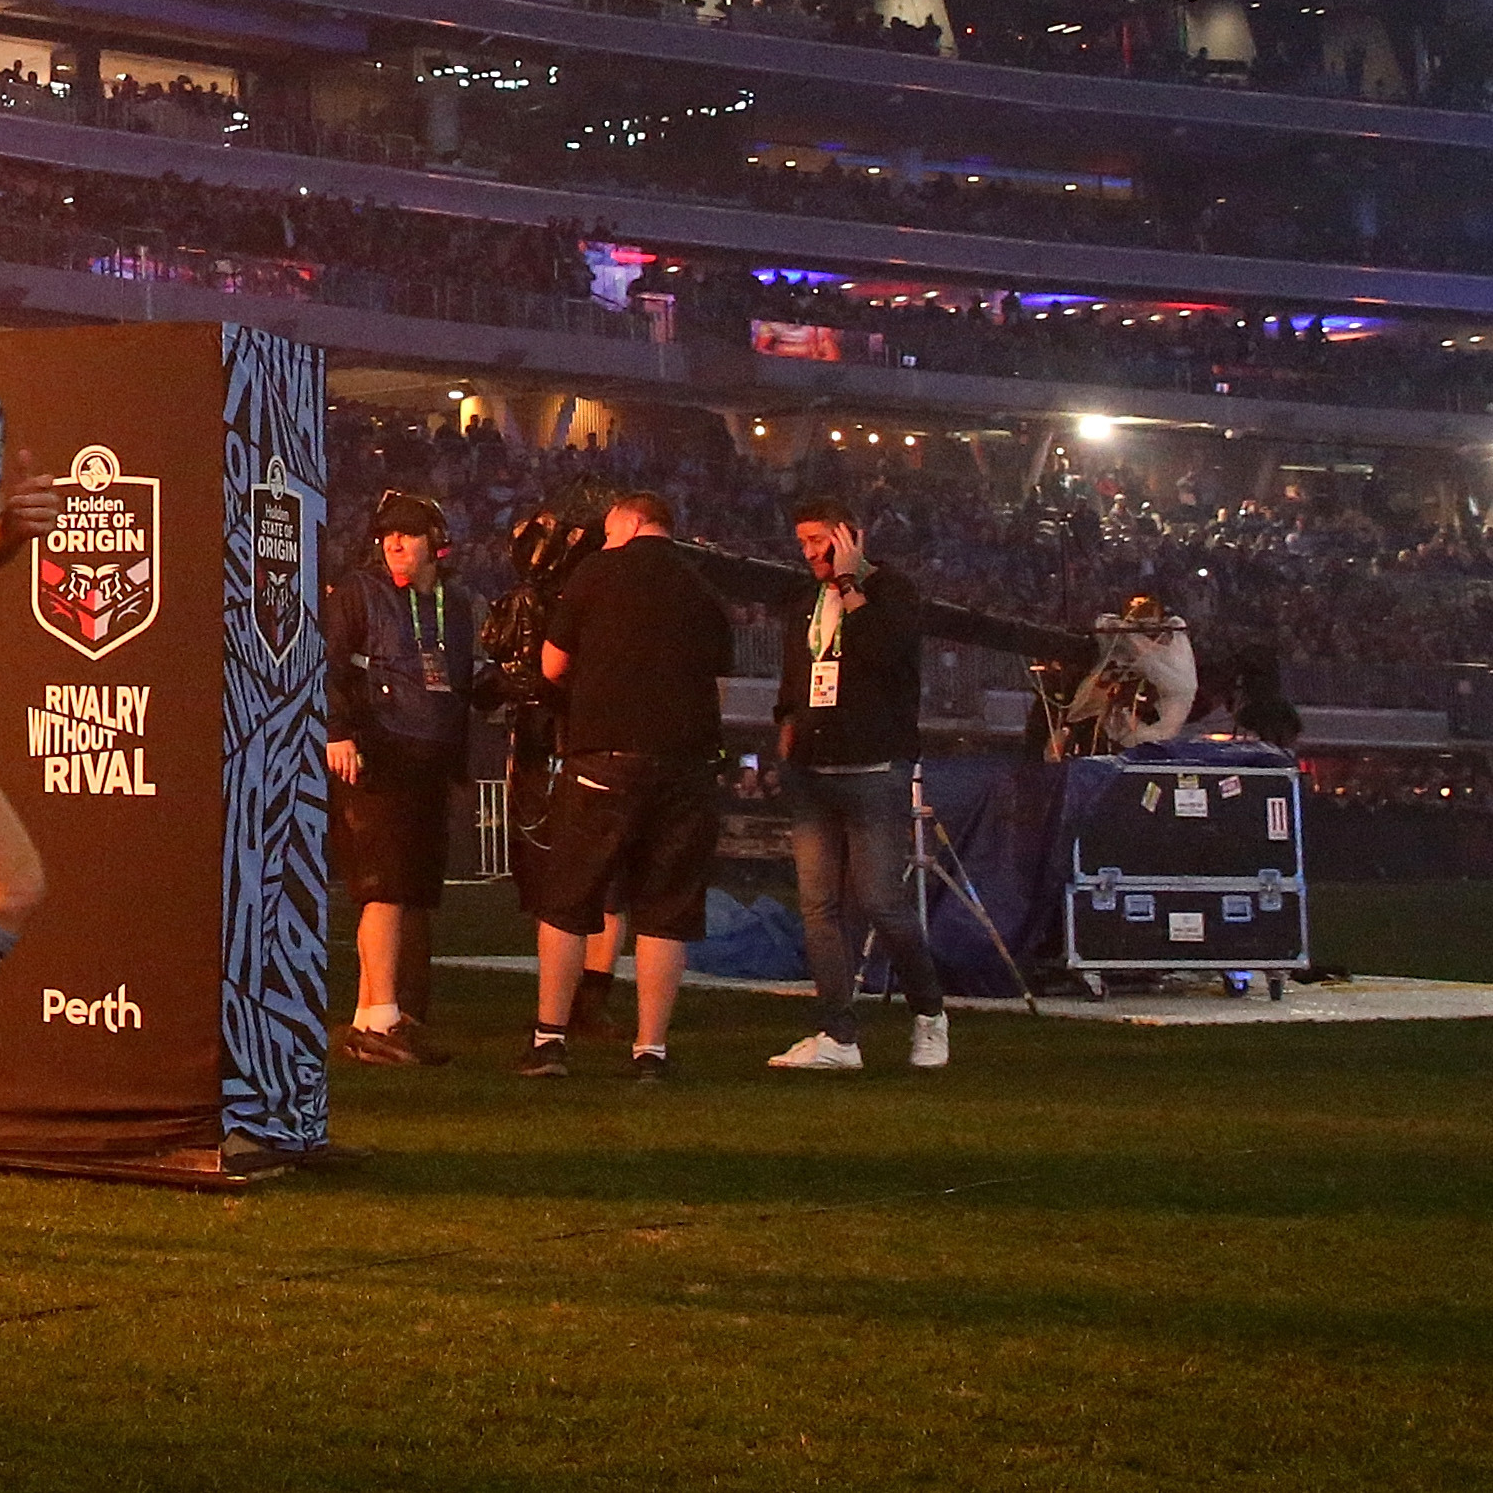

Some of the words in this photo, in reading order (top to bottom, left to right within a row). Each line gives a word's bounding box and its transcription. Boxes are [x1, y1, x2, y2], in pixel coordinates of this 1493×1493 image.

[67, 495, 124, 512] Holden
[56, 513, 109, 529] STATE
[112, 513, 135, 528] OF
[261, 520, 283, 537] STATE
[284, 524, 294, 538] OF
[47, 529, 145, 553] ORIGIN
[258, 535, 297, 563] ORIGIN
[45, 685, 151, 737] RIVALRY
[27, 706, 118, 757] WITHOUT
[44, 747, 156, 796] RIVAL
[43, 983, 141, 1033] Perth
